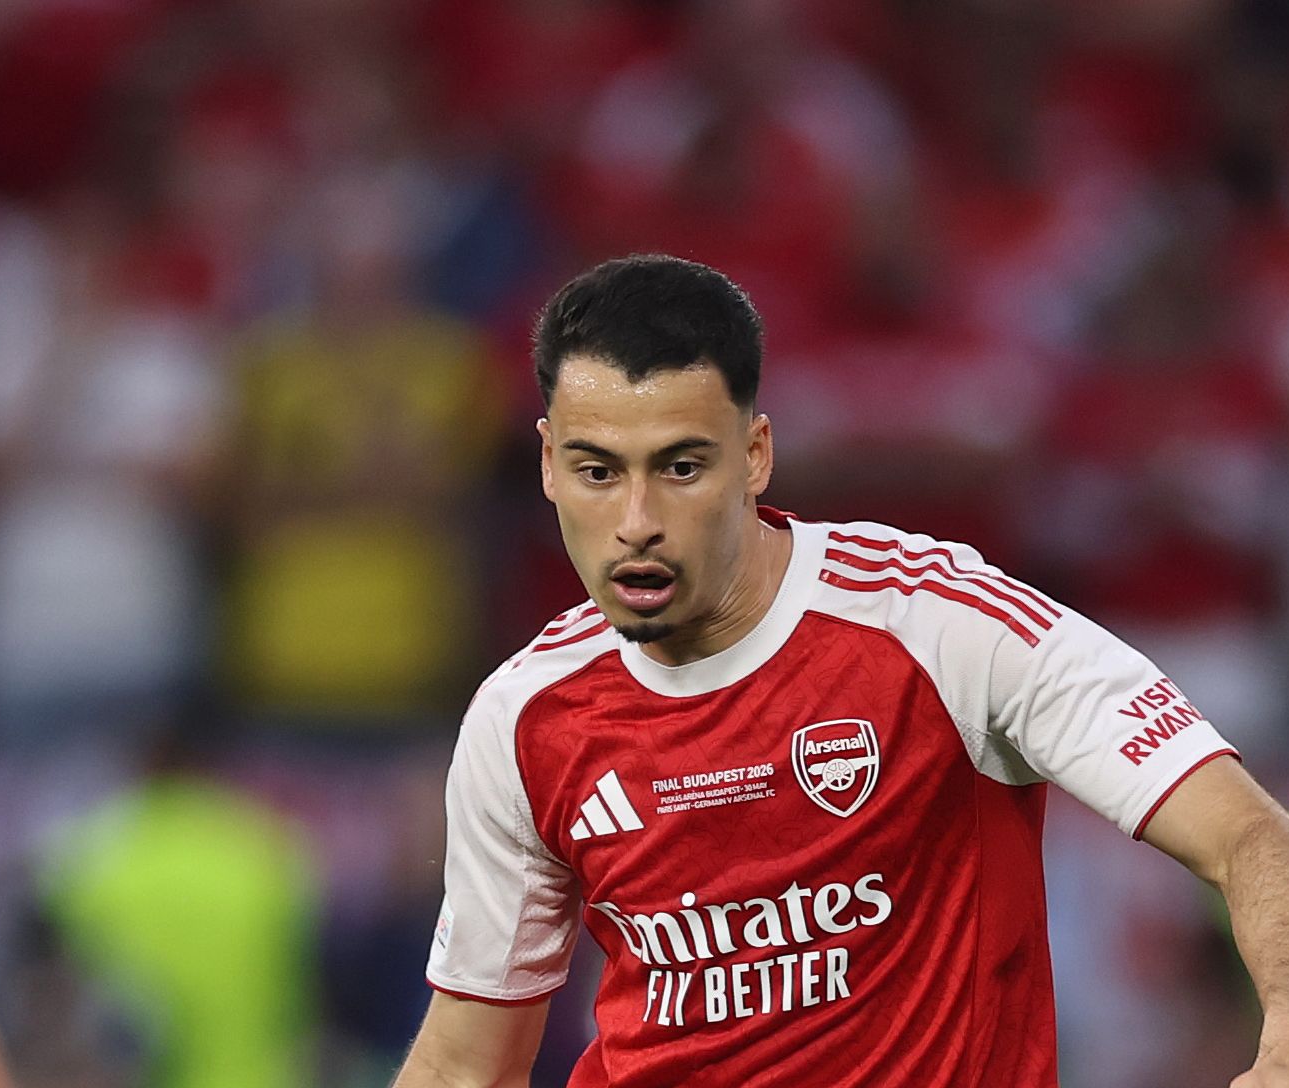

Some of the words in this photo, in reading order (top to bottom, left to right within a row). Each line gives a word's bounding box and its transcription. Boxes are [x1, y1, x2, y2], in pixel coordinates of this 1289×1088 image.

[804, 733, 865, 756] Arsenal
[652, 777, 682, 794] FINAL
[683, 768, 745, 788] BUDAPEST
[746, 763, 774, 779] 2026
[765, 788, 776, 798] FC
[589, 873, 893, 965] Emirates
[642, 969, 693, 1027] FLY
[703, 947, 852, 1024] BETTER
